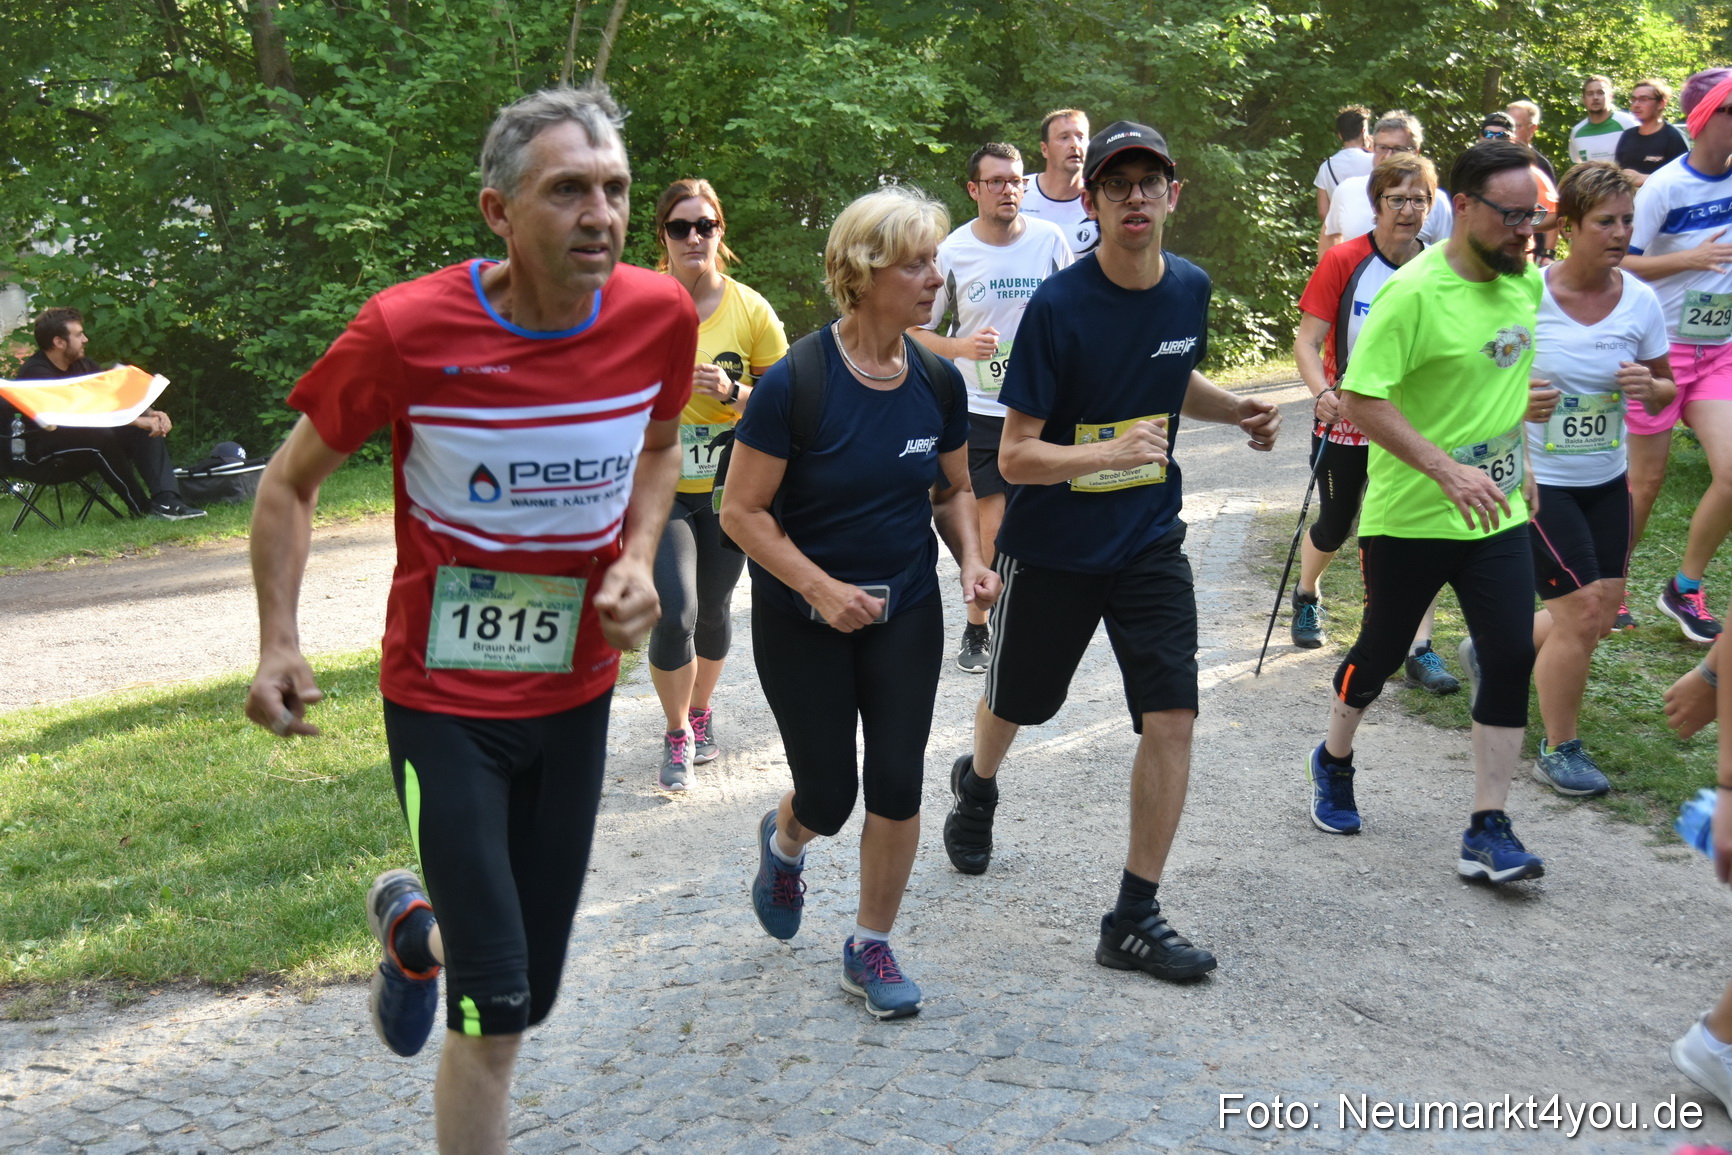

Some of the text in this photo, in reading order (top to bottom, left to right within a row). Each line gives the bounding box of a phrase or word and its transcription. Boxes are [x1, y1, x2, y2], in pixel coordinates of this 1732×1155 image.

[1687, 308, 1731, 326] 2429
[1595, 340, 1628, 350] Andrea
[1563, 414, 1607, 438] 650
[509, 450, 634, 485] Petry
[1099, 469, 1142, 481] Strobl Oliver
[510, 497, 557, 507] WÄRME
[452, 603, 560, 643] 1815
[473, 641, 531, 654] Braun Karl
